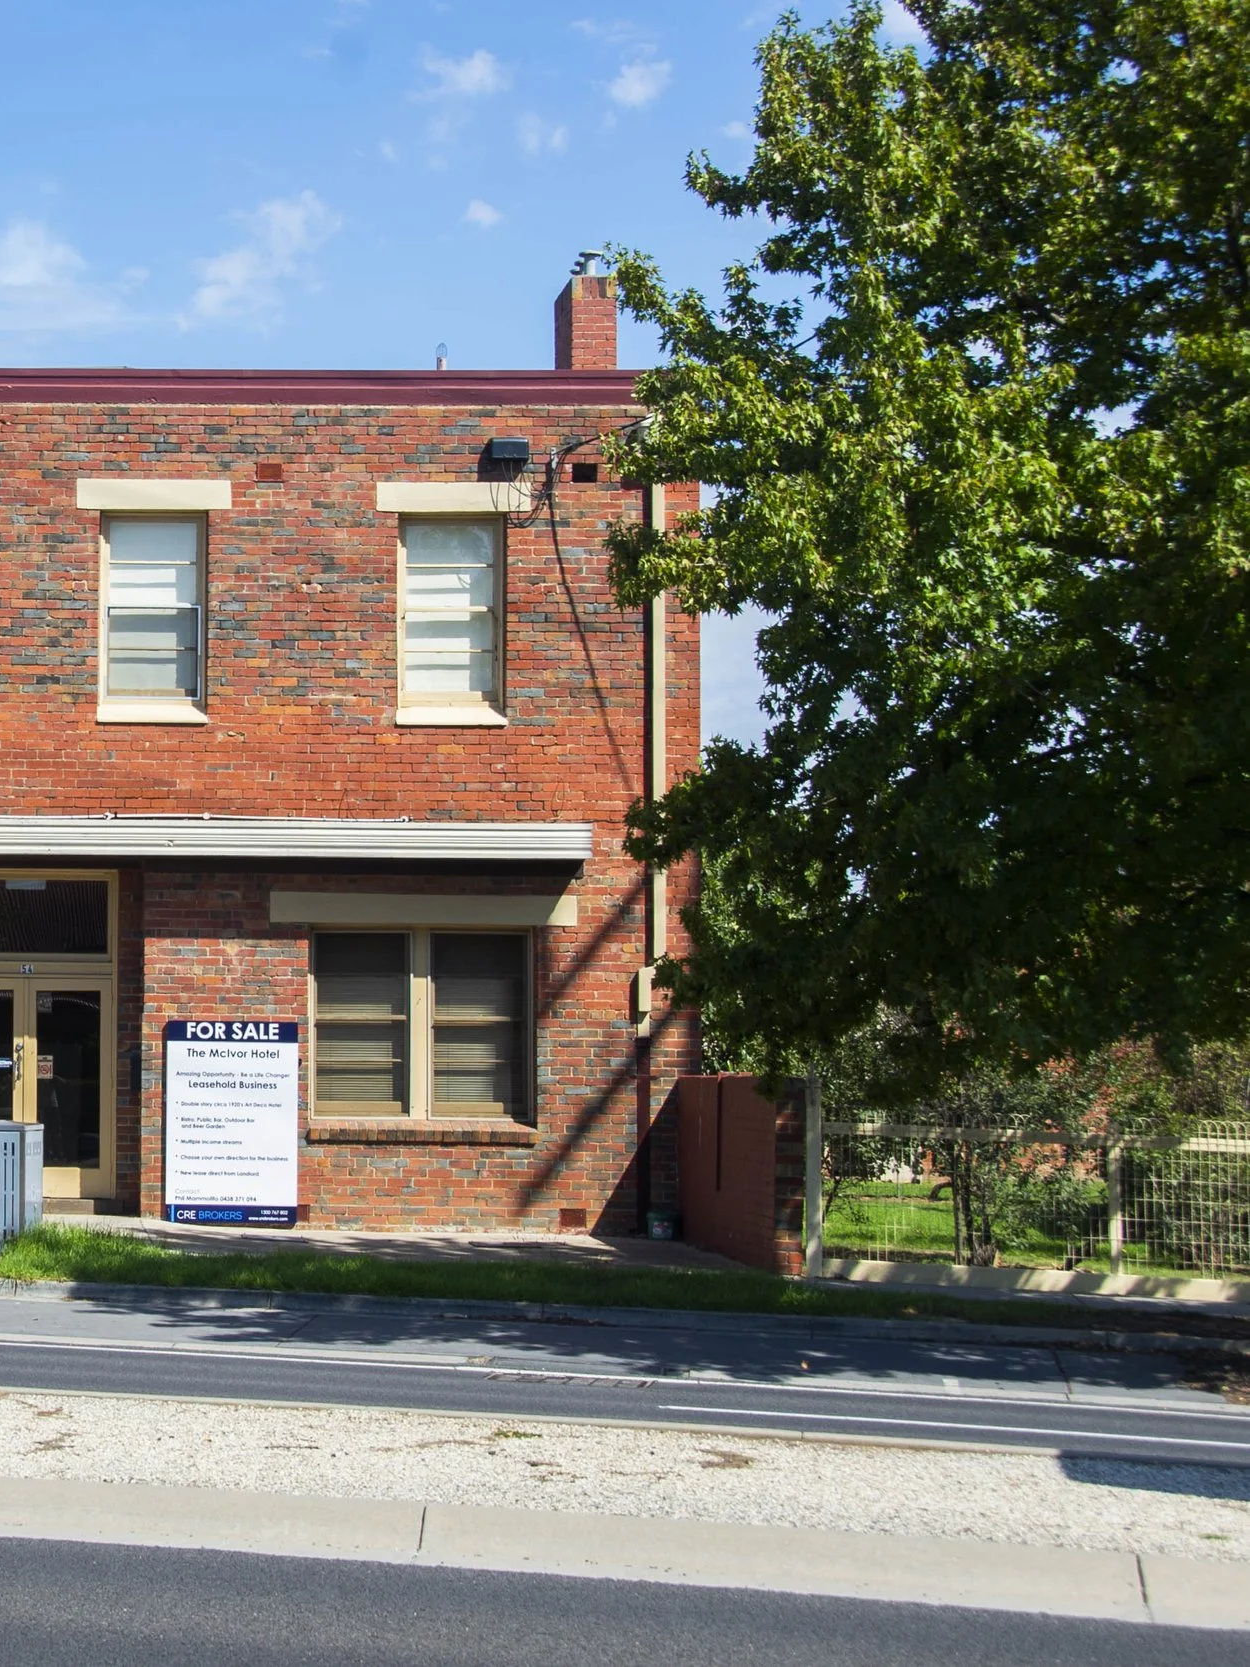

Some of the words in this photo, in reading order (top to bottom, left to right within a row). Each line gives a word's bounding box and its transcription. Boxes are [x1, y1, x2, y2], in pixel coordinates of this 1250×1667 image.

[21, 963, 33, 974] 54
[186, 1022, 226, 1040] FOR
[231, 1022, 280, 1041] SALE
[187, 1048, 206, 1057] The
[209, 1048, 247, 1058] McIvor
[251, 1049, 280, 1059] Hotel
[188, 1080, 236, 1089] Leasehold
[239, 1081, 277, 1090] Business
[176, 1210, 197, 1220] CRE
[198, 1210, 243, 1220] BROKERS
